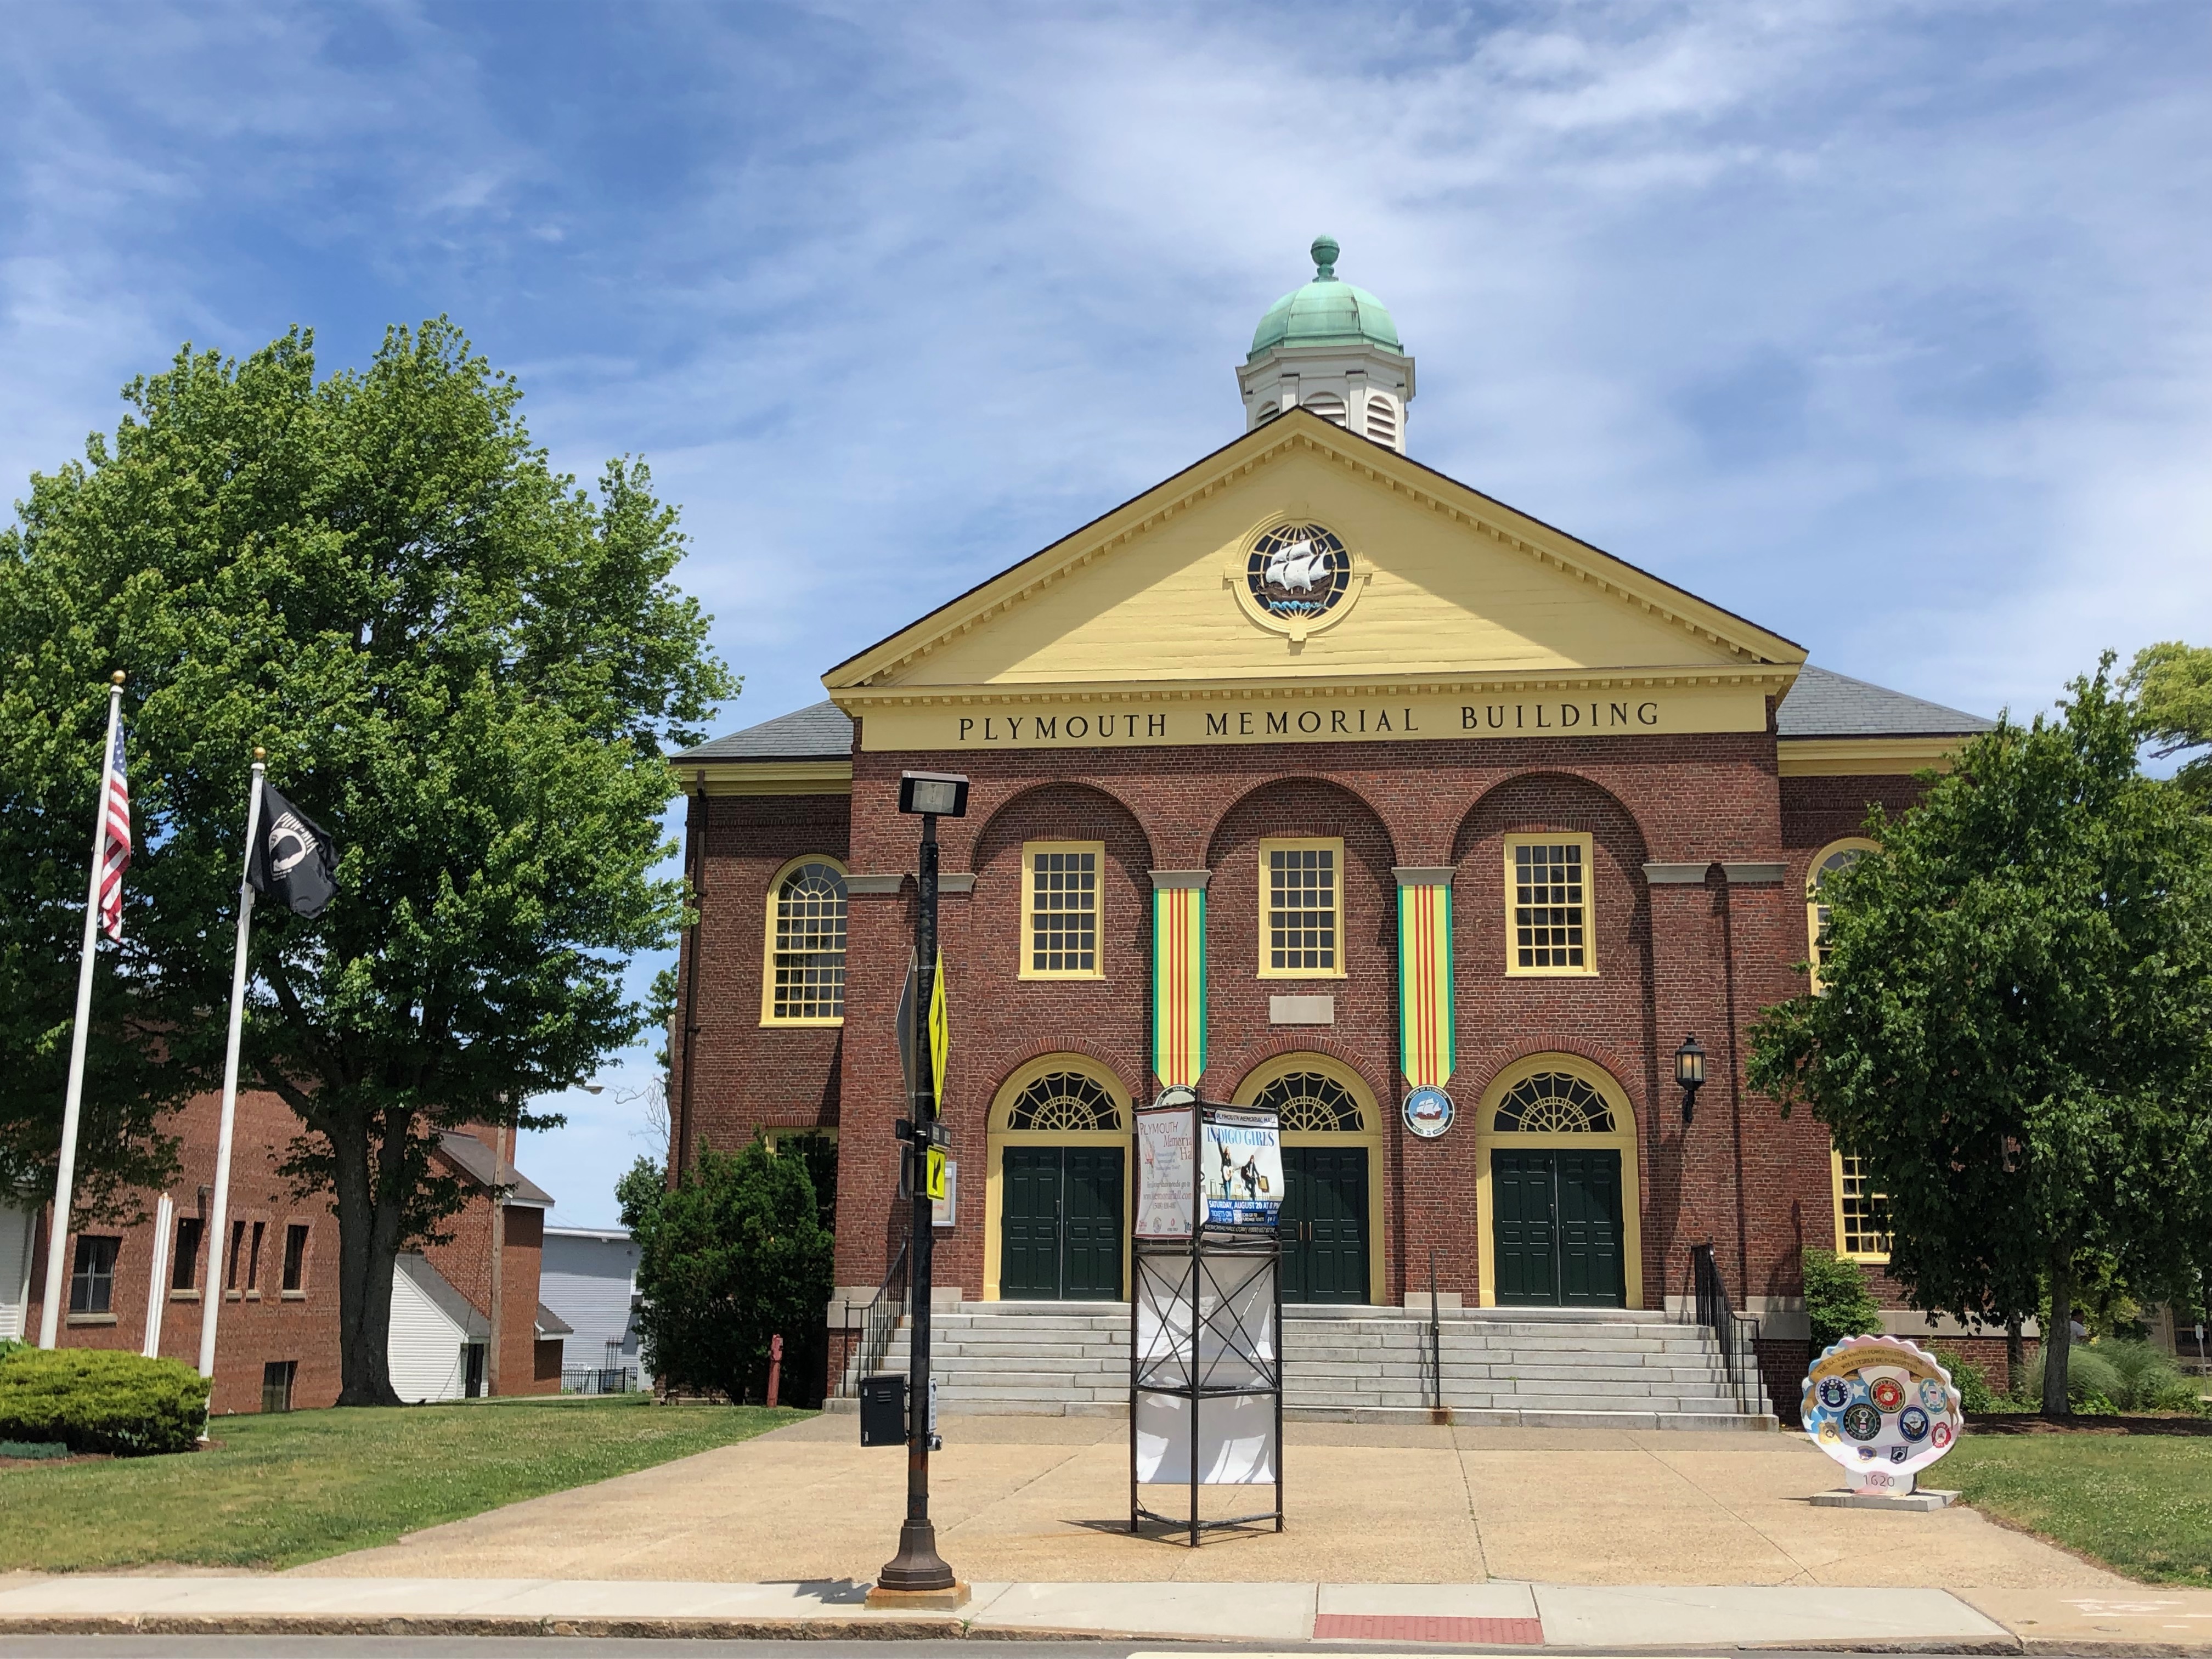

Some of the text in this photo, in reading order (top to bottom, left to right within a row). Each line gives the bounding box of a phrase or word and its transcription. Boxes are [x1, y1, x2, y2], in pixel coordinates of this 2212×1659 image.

[959, 702, 1660, 741] PLYMOUTH MEMORIAL BUILDING
[1409, 1090, 1420, 1099] TOWN
[1426, 1087, 1448, 1099] PLYMOUTH
[1139, 1121, 1178, 1135] PLYMOUTH
[1206, 1127, 1274, 1147] INDIGO GIRLS
[1209, 1200, 1233, 1210] SATURDAY,
[1234, 1201, 1255, 1209] AUGUST
[1817, 1363, 1828, 1375] THE
[1827, 1354, 1847, 1366] NATION
[1863, 1475, 1895, 1487] 1620
